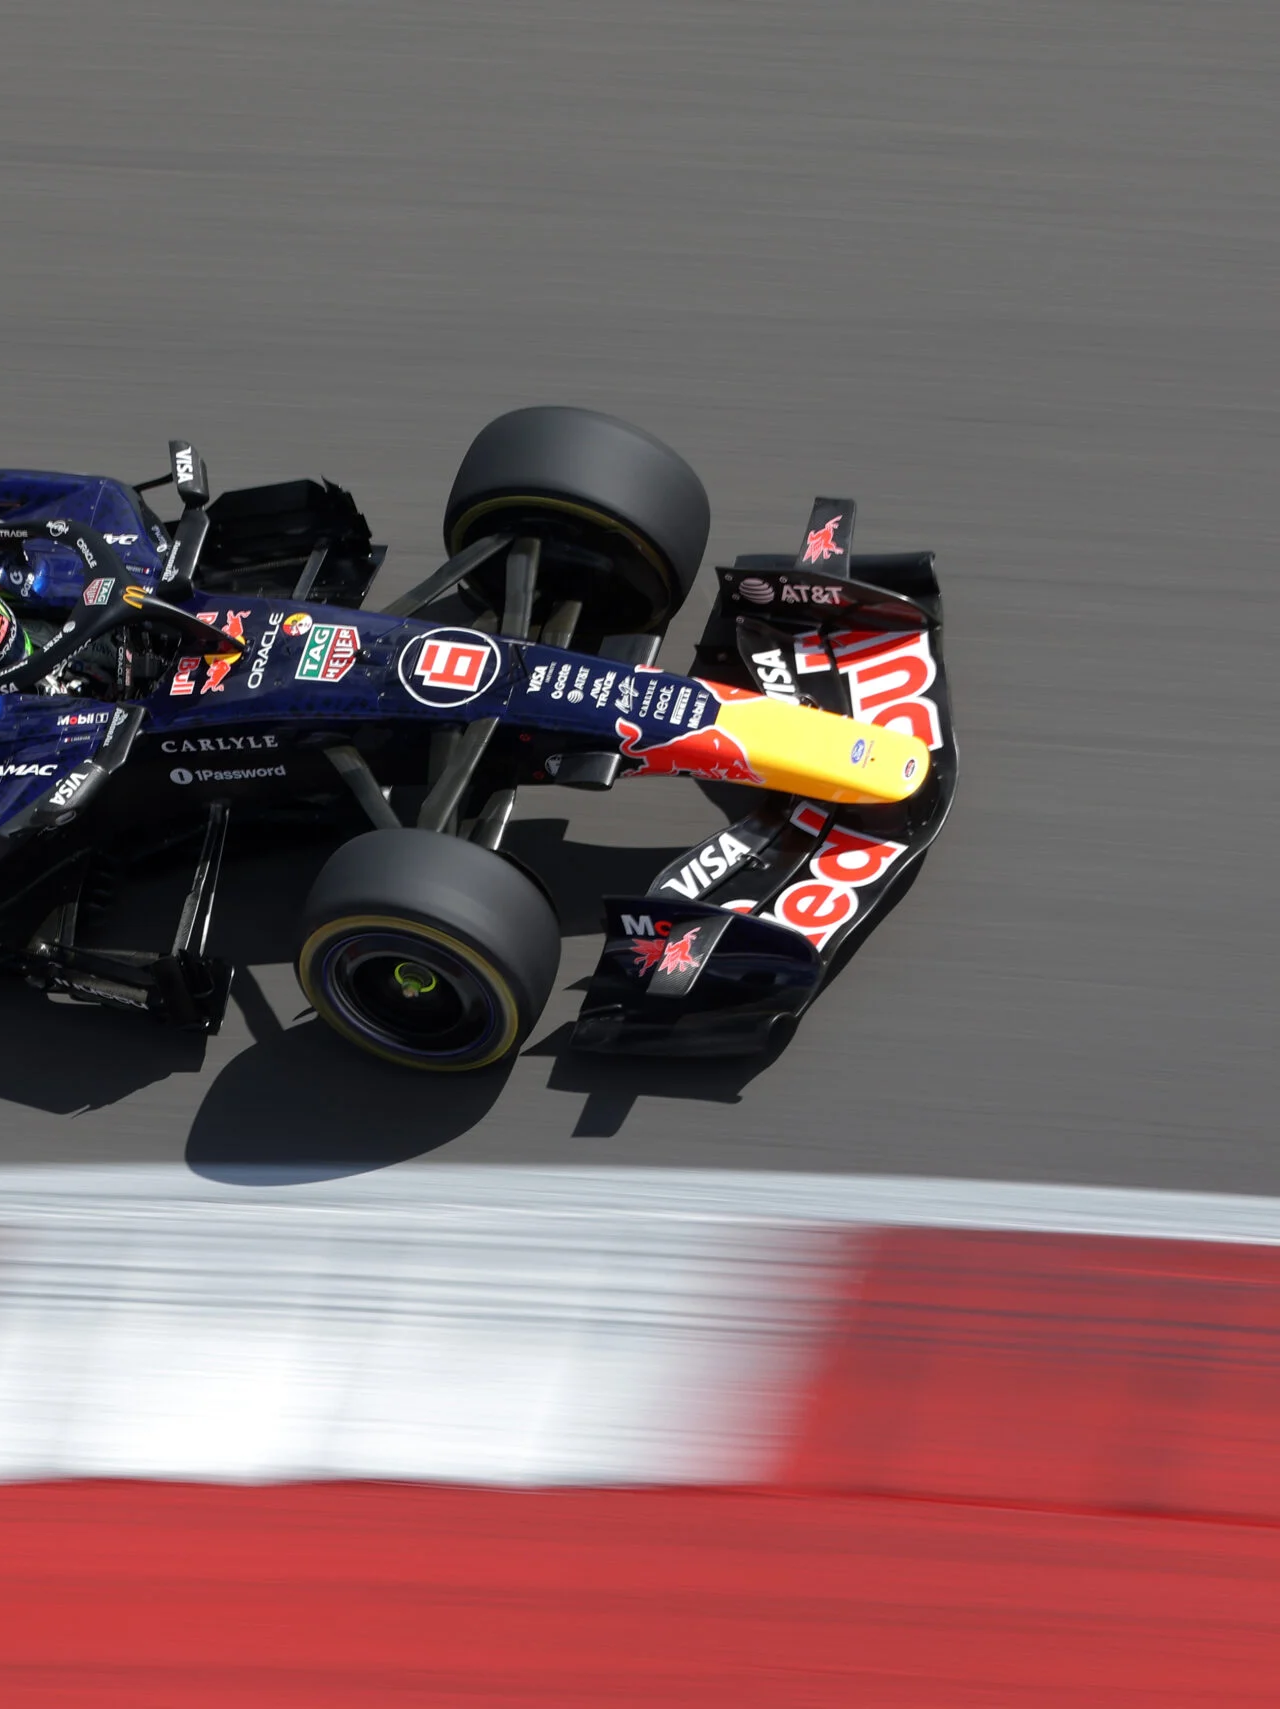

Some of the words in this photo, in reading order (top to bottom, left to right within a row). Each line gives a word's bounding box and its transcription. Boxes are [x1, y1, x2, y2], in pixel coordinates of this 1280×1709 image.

[175, 446, 193, 484] VISA
[76, 537, 97, 569] ORACLE
[98, 580, 112, 604] TAG
[781, 584, 844, 605] AT&T
[248, 612, 284, 689] ORACLE
[302, 627, 331, 677] TAG
[326, 629, 358, 680] HEUER
[414, 639, 491, 692] 6
[170, 657, 201, 695] Bull
[527, 666, 548, 694] VISA
[554, 664, 572, 691] Gate
[574, 665, 590, 690] AT&T
[596, 670, 617, 708] TRADE
[639, 679, 658, 717] CARLYLE
[57, 713, 94, 726] Mobil
[687, 702, 705, 729] Mobil
[161, 735, 279, 753] CARLYLE
[49, 772, 89, 806] VISA
[195, 764, 286, 782] 1Password
[661, 832, 750, 899] VISA
[722, 800, 908, 952] ed
